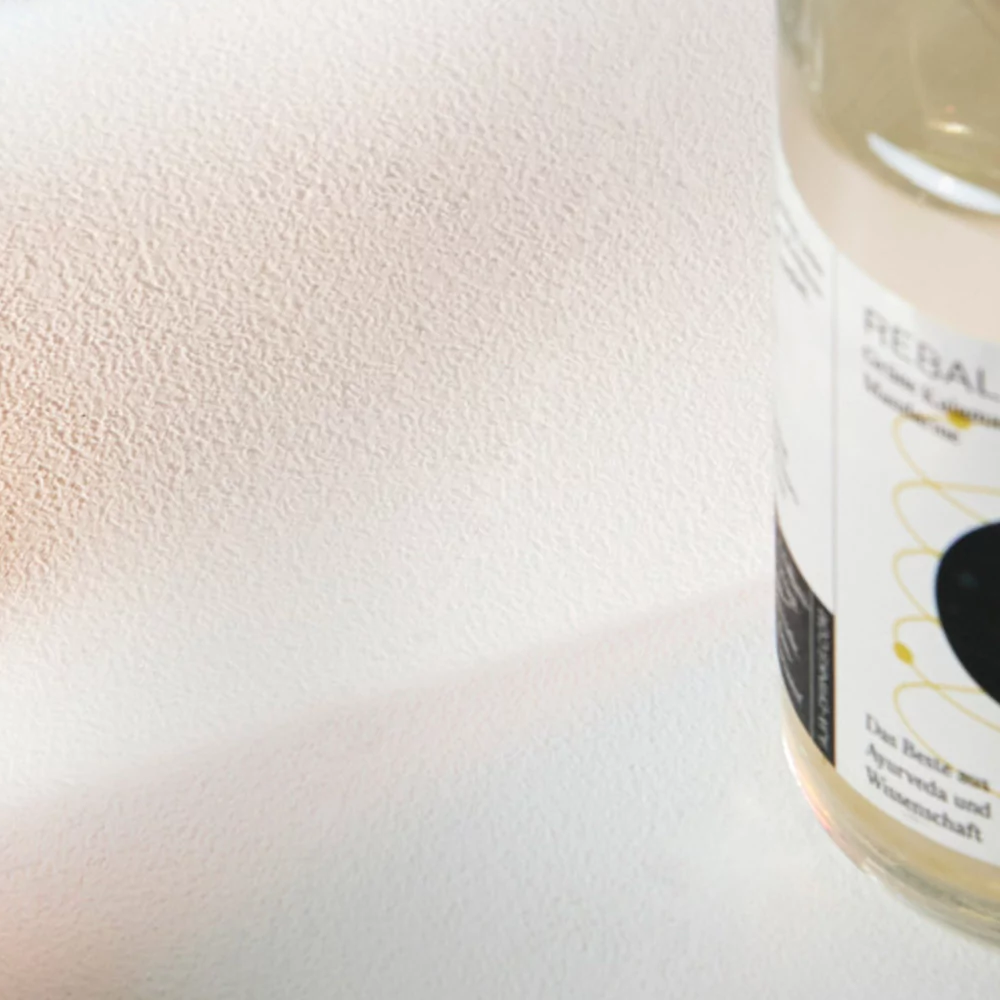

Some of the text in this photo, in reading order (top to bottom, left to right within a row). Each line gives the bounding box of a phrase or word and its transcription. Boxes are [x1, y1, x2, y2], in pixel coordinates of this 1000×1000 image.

[863, 306, 1000, 402] REBAL
[865, 712, 897, 750] Das
[902, 736, 951, 778] Beste
[865, 743, 991, 820] Ayurveda und
[865, 764, 984, 843] Wissenschaft
